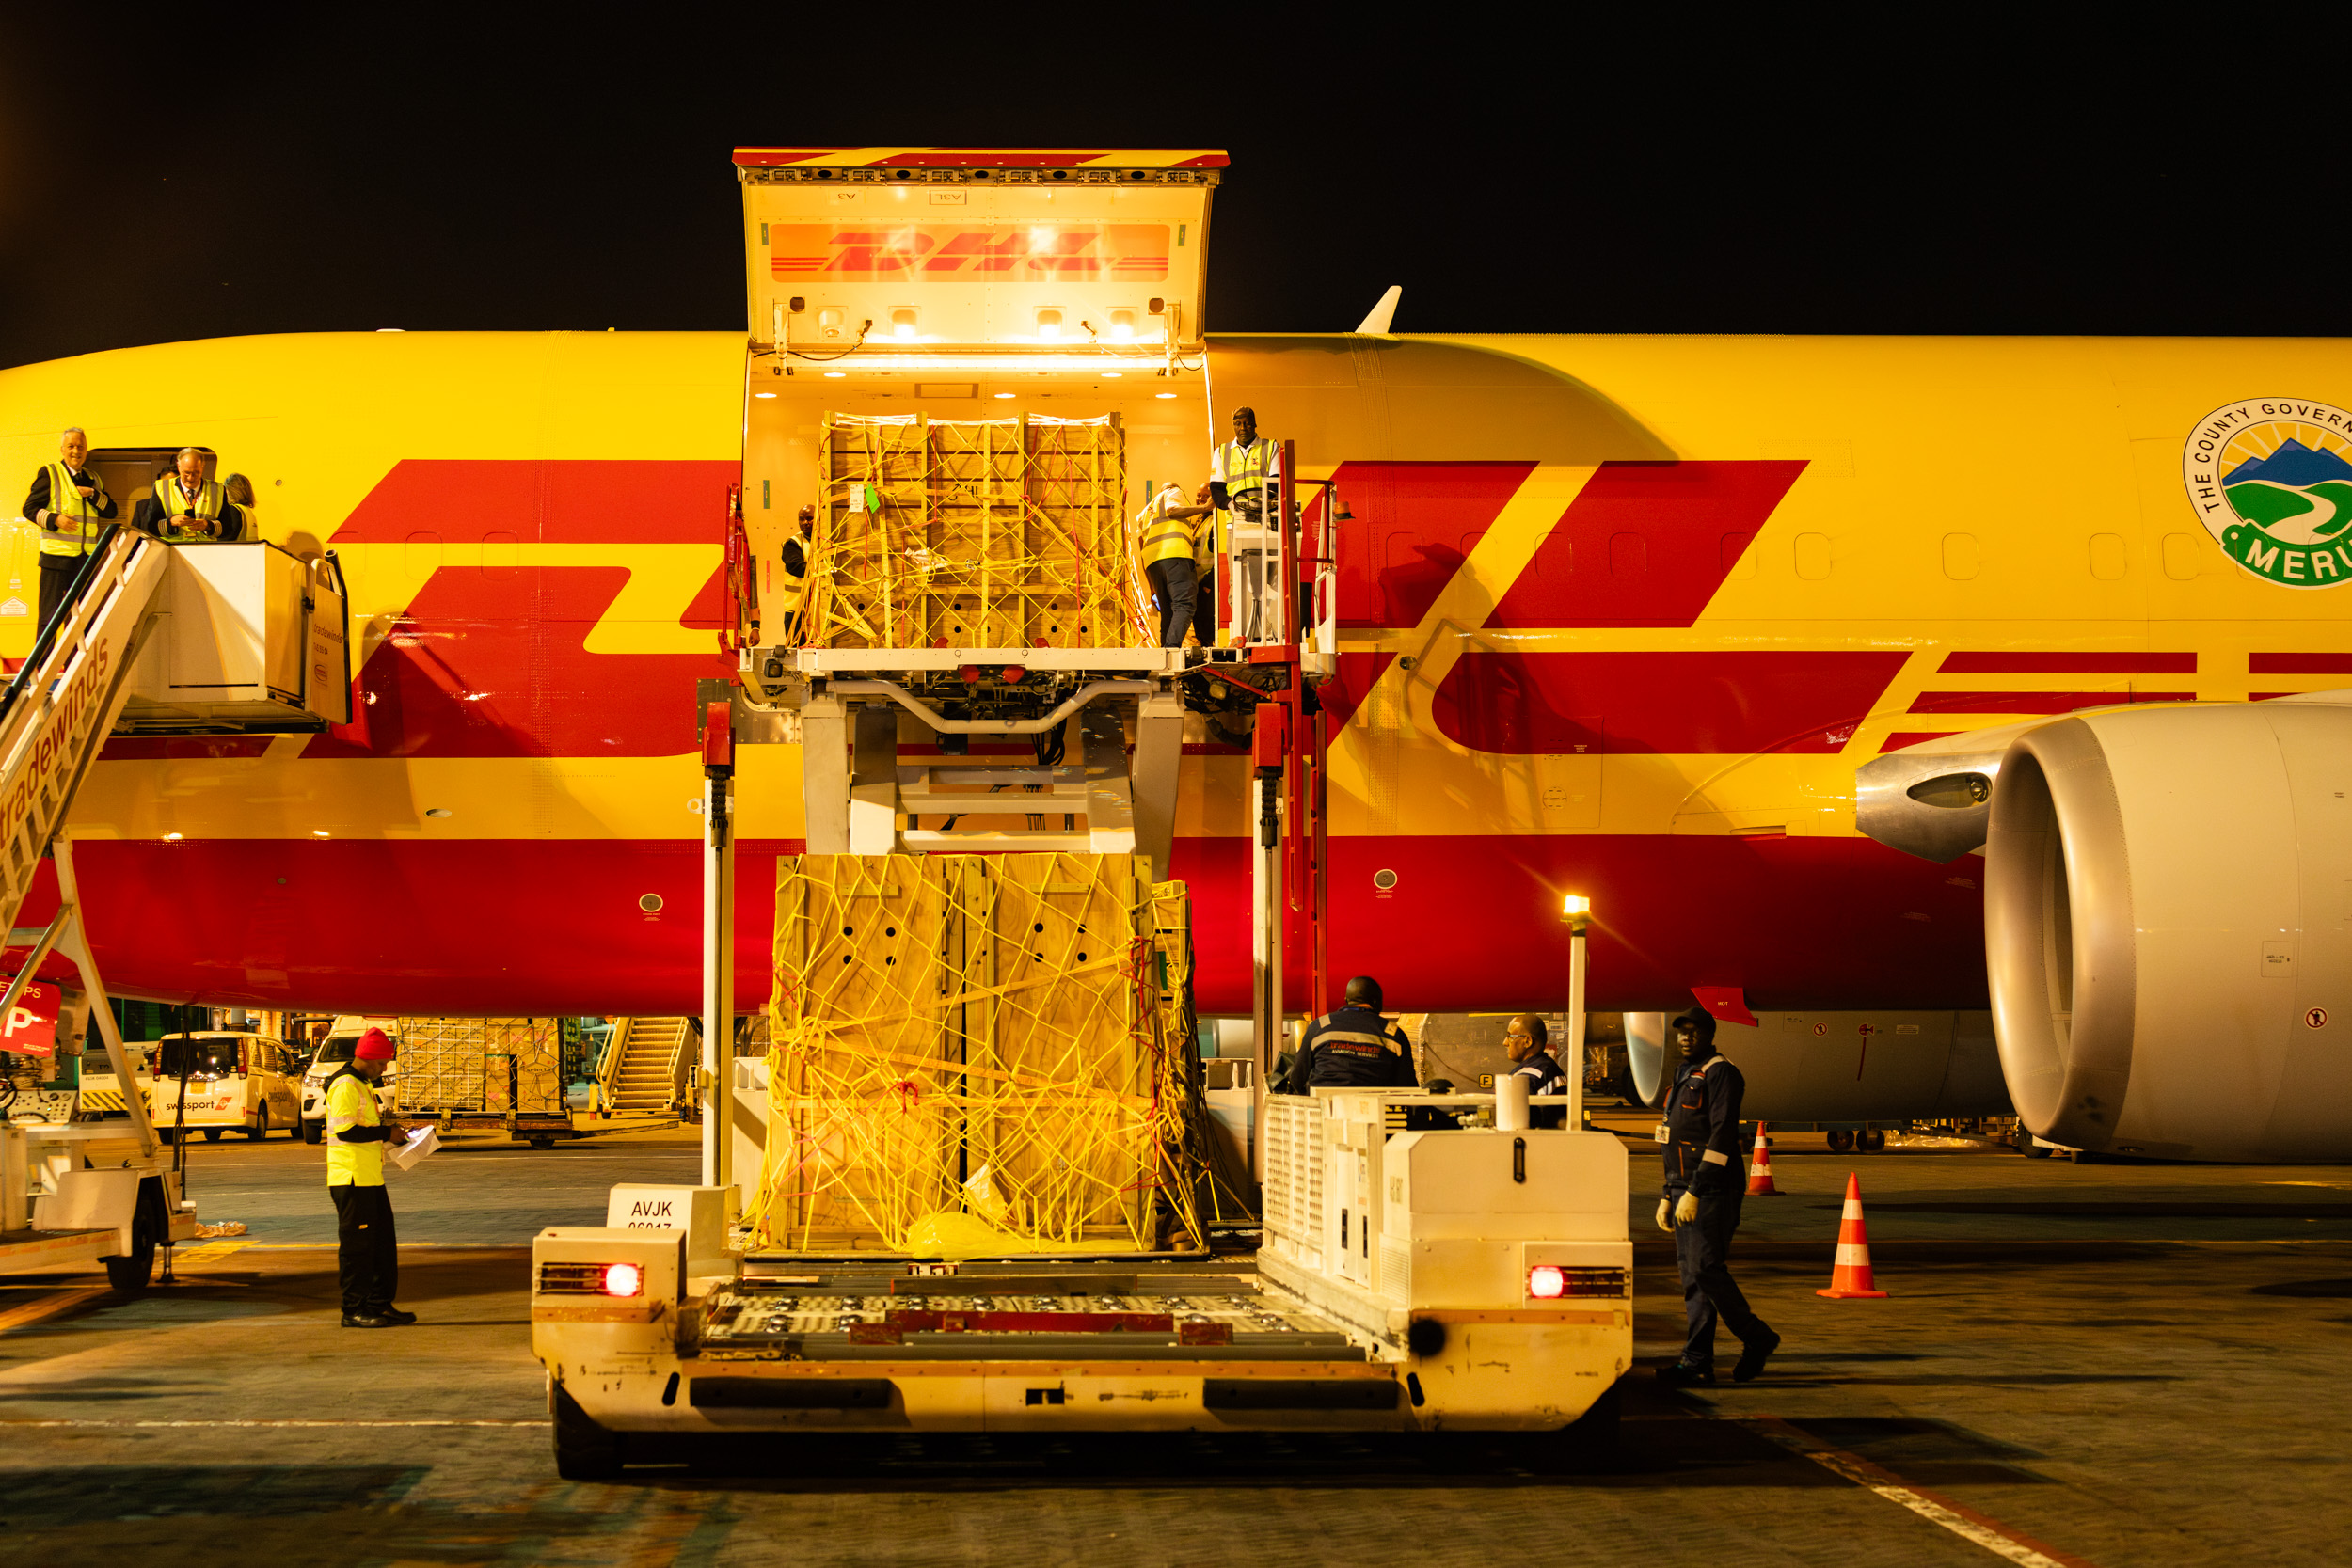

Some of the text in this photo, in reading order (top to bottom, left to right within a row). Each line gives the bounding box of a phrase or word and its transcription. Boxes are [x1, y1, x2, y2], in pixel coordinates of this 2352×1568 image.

[823, 232, 1117, 271] DHL
[2194, 407, 2250, 463] COUNTY
[2195, 474, 2220, 513] THE
[313, 623, 343, 644] tradewinds
[0, 637, 108, 848] tradewinds
[1330, 1041, 1380, 1053] tradewinds
[166, 1101, 215, 1111] swssport
[631, 1201, 673, 1216] AVJK
